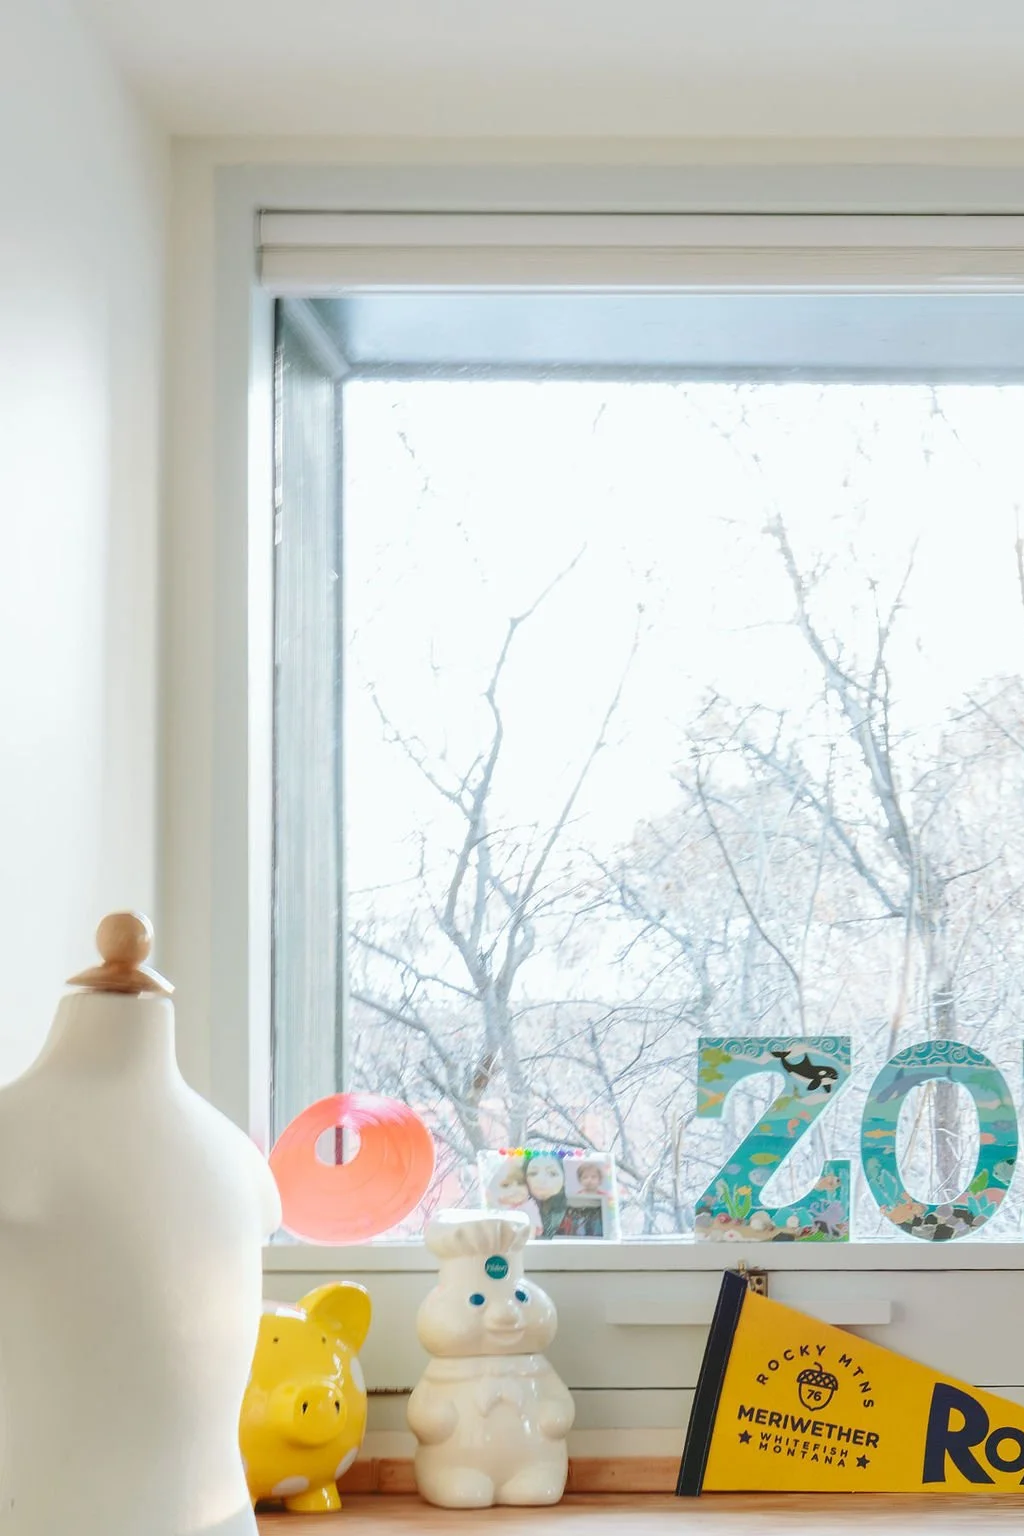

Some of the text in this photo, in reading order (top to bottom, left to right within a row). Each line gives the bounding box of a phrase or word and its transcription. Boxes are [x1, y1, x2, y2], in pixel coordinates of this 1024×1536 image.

[756, 1344, 875, 1408] ROCKY MTNS
[806, 1388, 822, 1401] 76
[737, 1404, 880, 1448] MERIWETHER
[759, 1442, 846, 1467] MONTANA
[760, 1432, 848, 1458] WHITEFISH
